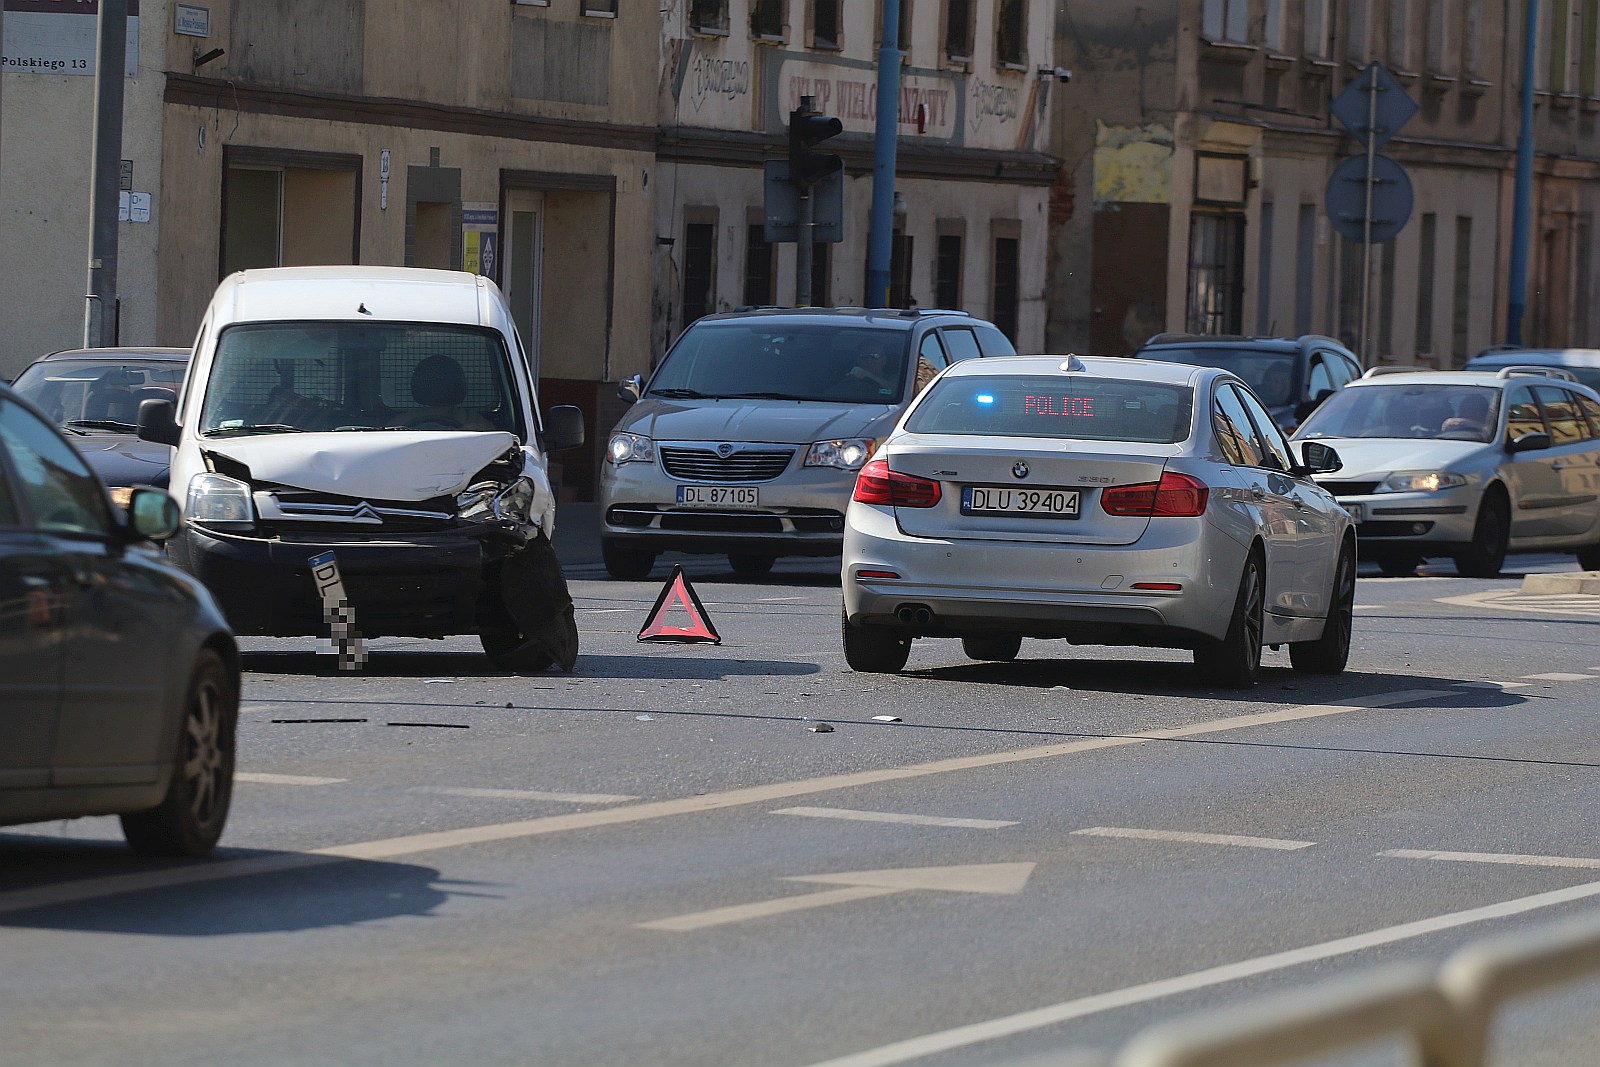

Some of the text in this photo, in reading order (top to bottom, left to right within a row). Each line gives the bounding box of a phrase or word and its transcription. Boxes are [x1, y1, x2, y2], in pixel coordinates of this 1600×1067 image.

[2, 57, 87, 70] Polskiego 13
[1024, 395, 1095, 417] POLICE
[686, 488, 755, 503] DL 87105
[973, 489, 1077, 513] DLU 39404
